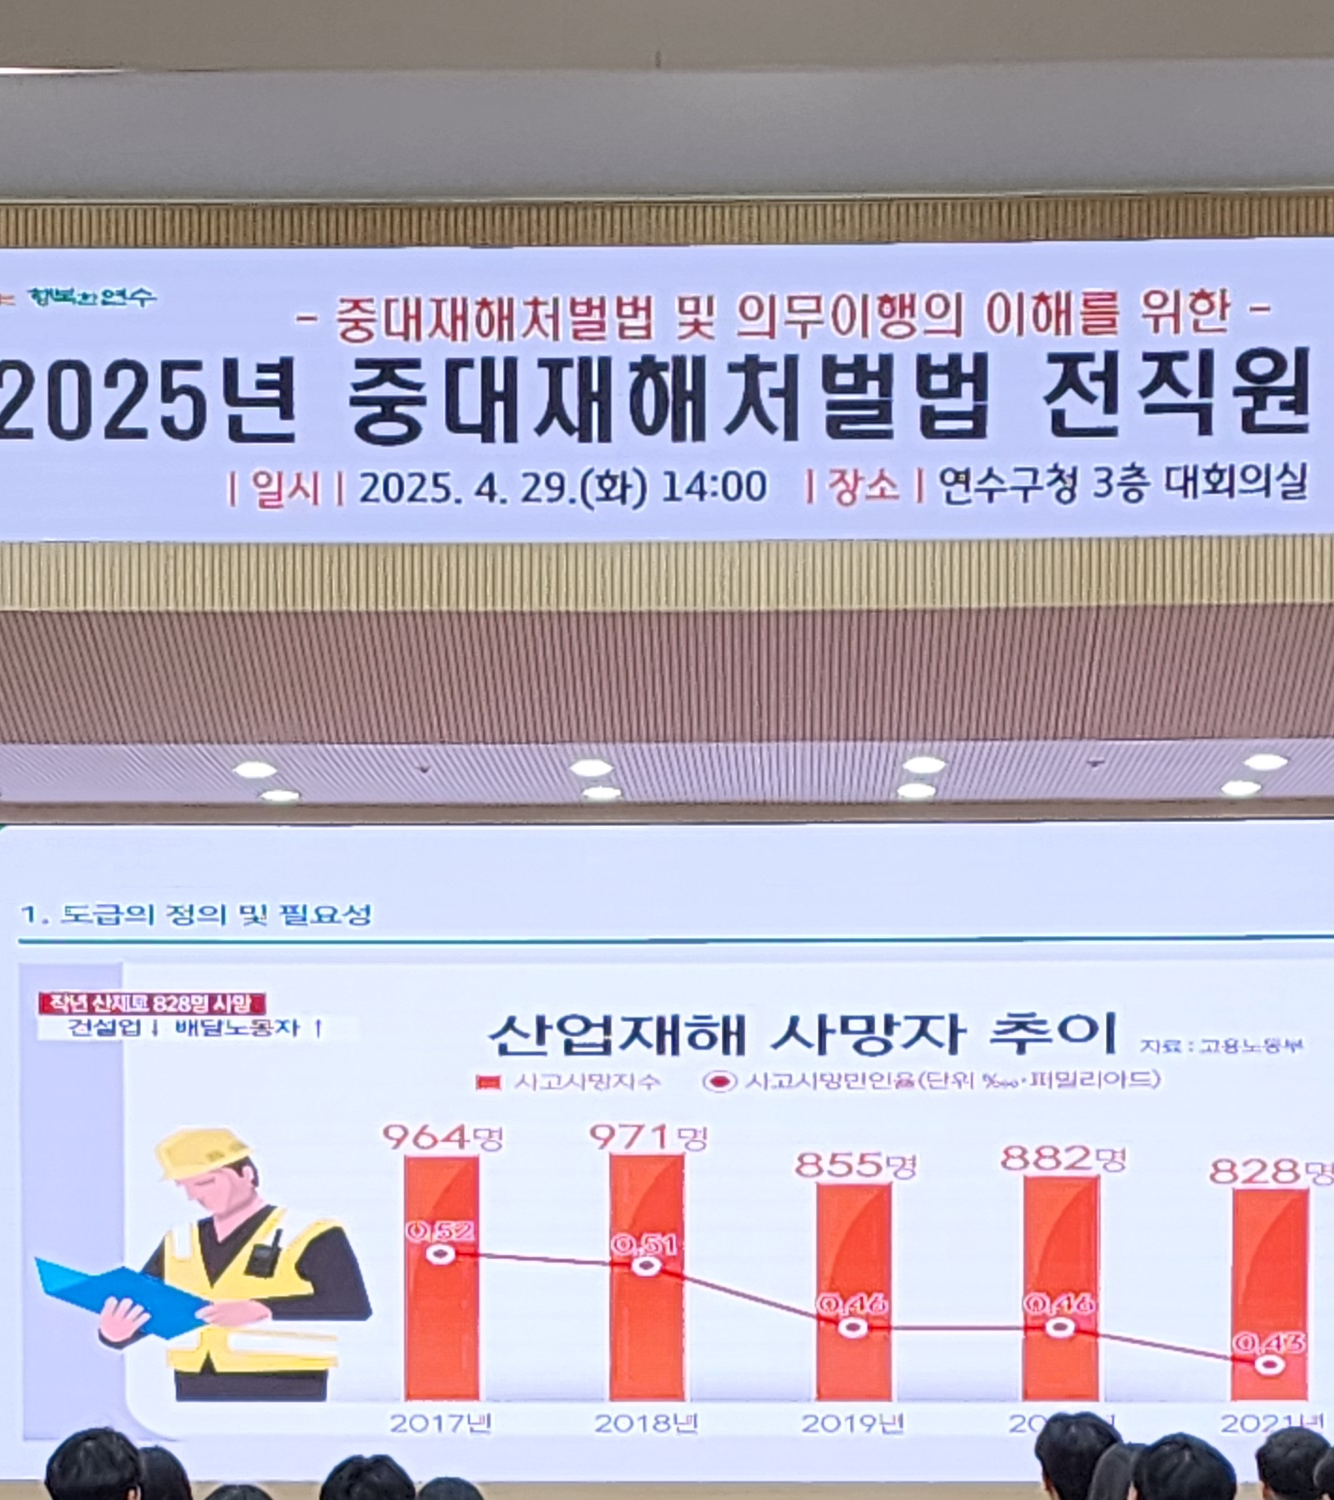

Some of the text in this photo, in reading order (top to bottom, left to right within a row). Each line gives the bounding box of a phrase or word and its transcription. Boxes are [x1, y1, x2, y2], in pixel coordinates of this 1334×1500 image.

[336, 295, 654, 342] 중대재해처벌법
[676, 294, 716, 341] 및
[736, 292, 963, 340] 의무이행의
[986, 290, 1120, 338] 이해를
[1140, 287, 1231, 336] 위한
[348, 351, 989, 447] 중대재해처벌법
[1043, 347, 1309, 439] 전직원
[359, 471, 463, 504] 2025.
[474, 472, 507, 504] 4.
[521, 467, 648, 511] 29.(화)
[663, 470, 767, 502] 14:00
[939, 463, 1079, 504] 연수구청
[1092, 462, 1151, 501] 3층
[1165, 461, 1309, 501] 대회의실
[21, 903, 372, 926] 1. 도급의 정의 및 필요성
[67, 1018, 142, 1038] 건설업
[486, 1012, 1117, 1057] 산업재해 사망자 추이
[381, 1122, 504, 1153] 964명
[588, 1122, 709, 1153] 971명
[794, 1151, 918, 1181] 855명
[1000, 1144, 1127, 1173] 882명
[389, 1412, 493, 1436] 2017년
[594, 1412, 699, 1436] 2018년
[800, 1412, 905, 1436] 2019년
